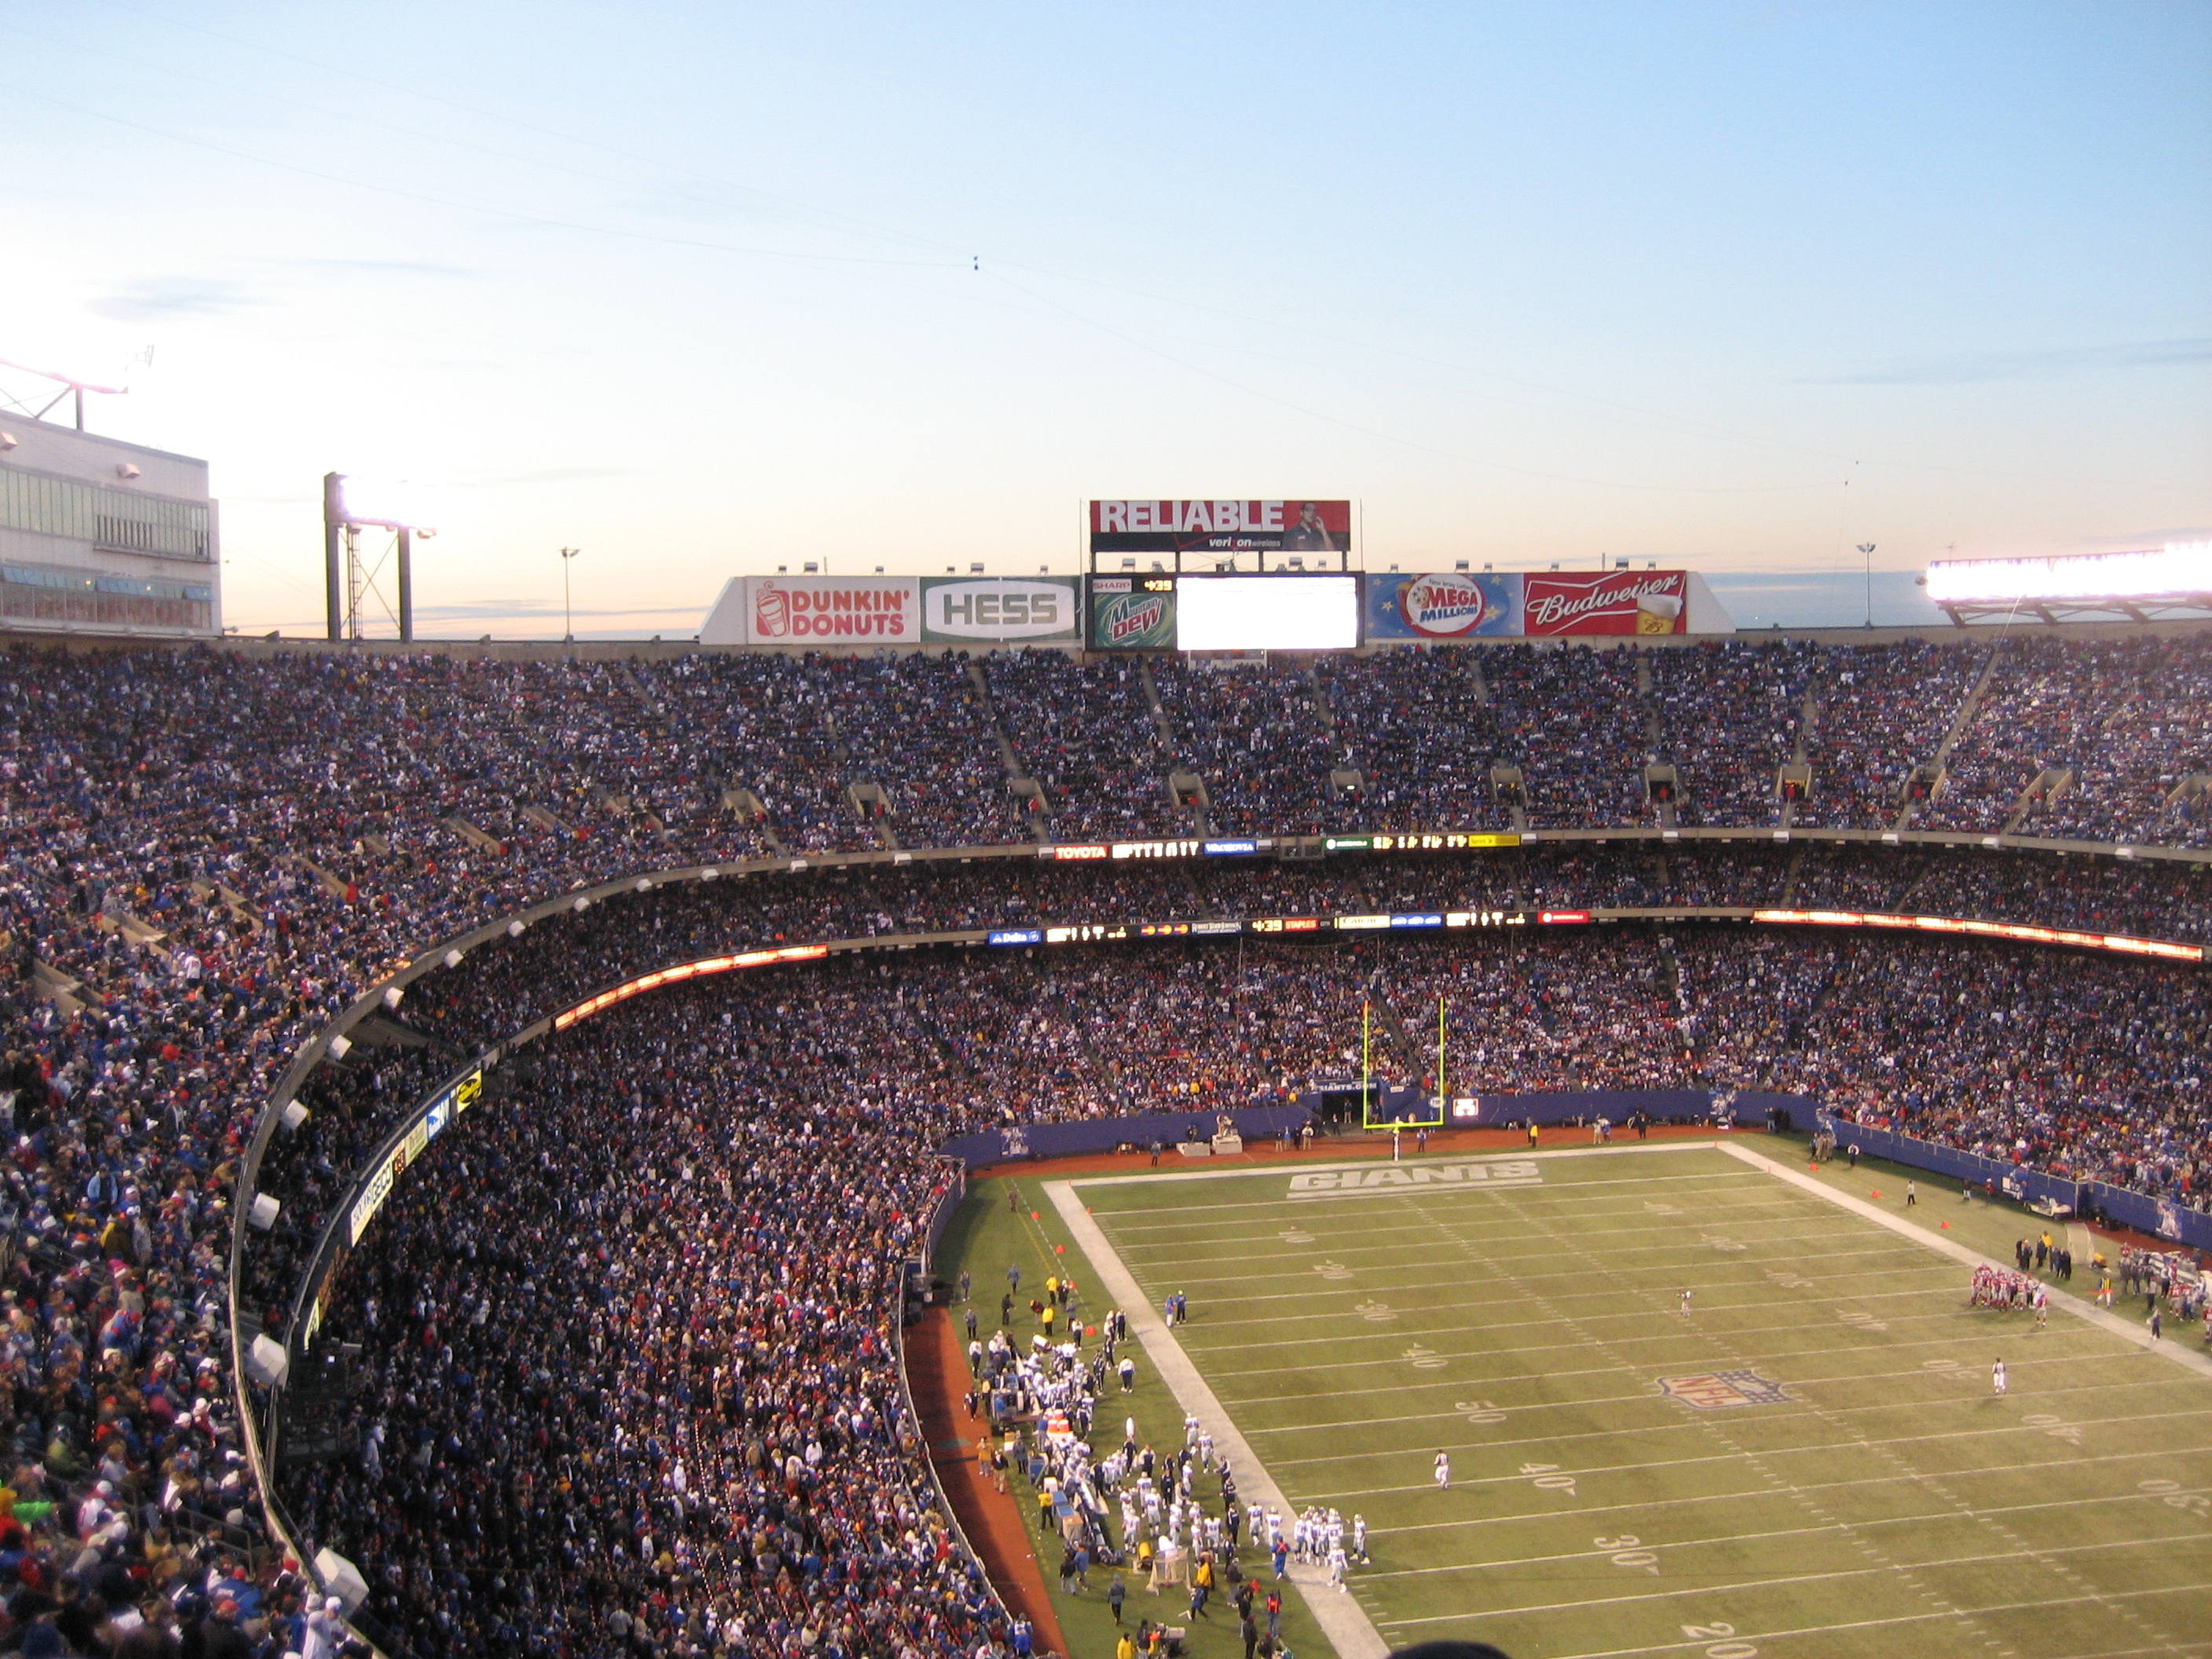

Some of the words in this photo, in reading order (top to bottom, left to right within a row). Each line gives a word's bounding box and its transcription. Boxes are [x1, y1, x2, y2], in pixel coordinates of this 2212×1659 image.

[1100, 500, 1285, 533] RELIABLE
[793, 590, 910, 612] DUNKIN'
[943, 593, 1057, 625] HESS
[1420, 585, 1478, 610] MEGA
[1527, 573, 1679, 626] Budweiser
[793, 613, 905, 636] DONUTS
[1420, 606, 1478, 622] MILLIONS
[1056, 846, 1106, 859] TOYOTA
[1003, 932, 1027, 943] Delta
[1285, 920, 1317, 931] STAPLES
[1289, 1161, 1540, 1190] GIANTS
[1671, 1375, 1741, 1406] NFL
[1454, 1400, 1507, 1424] 50
[1519, 1462, 1577, 1489] 40
[1593, 1534, 1659, 1567] 30
[1680, 1621, 1759, 1659] 20
